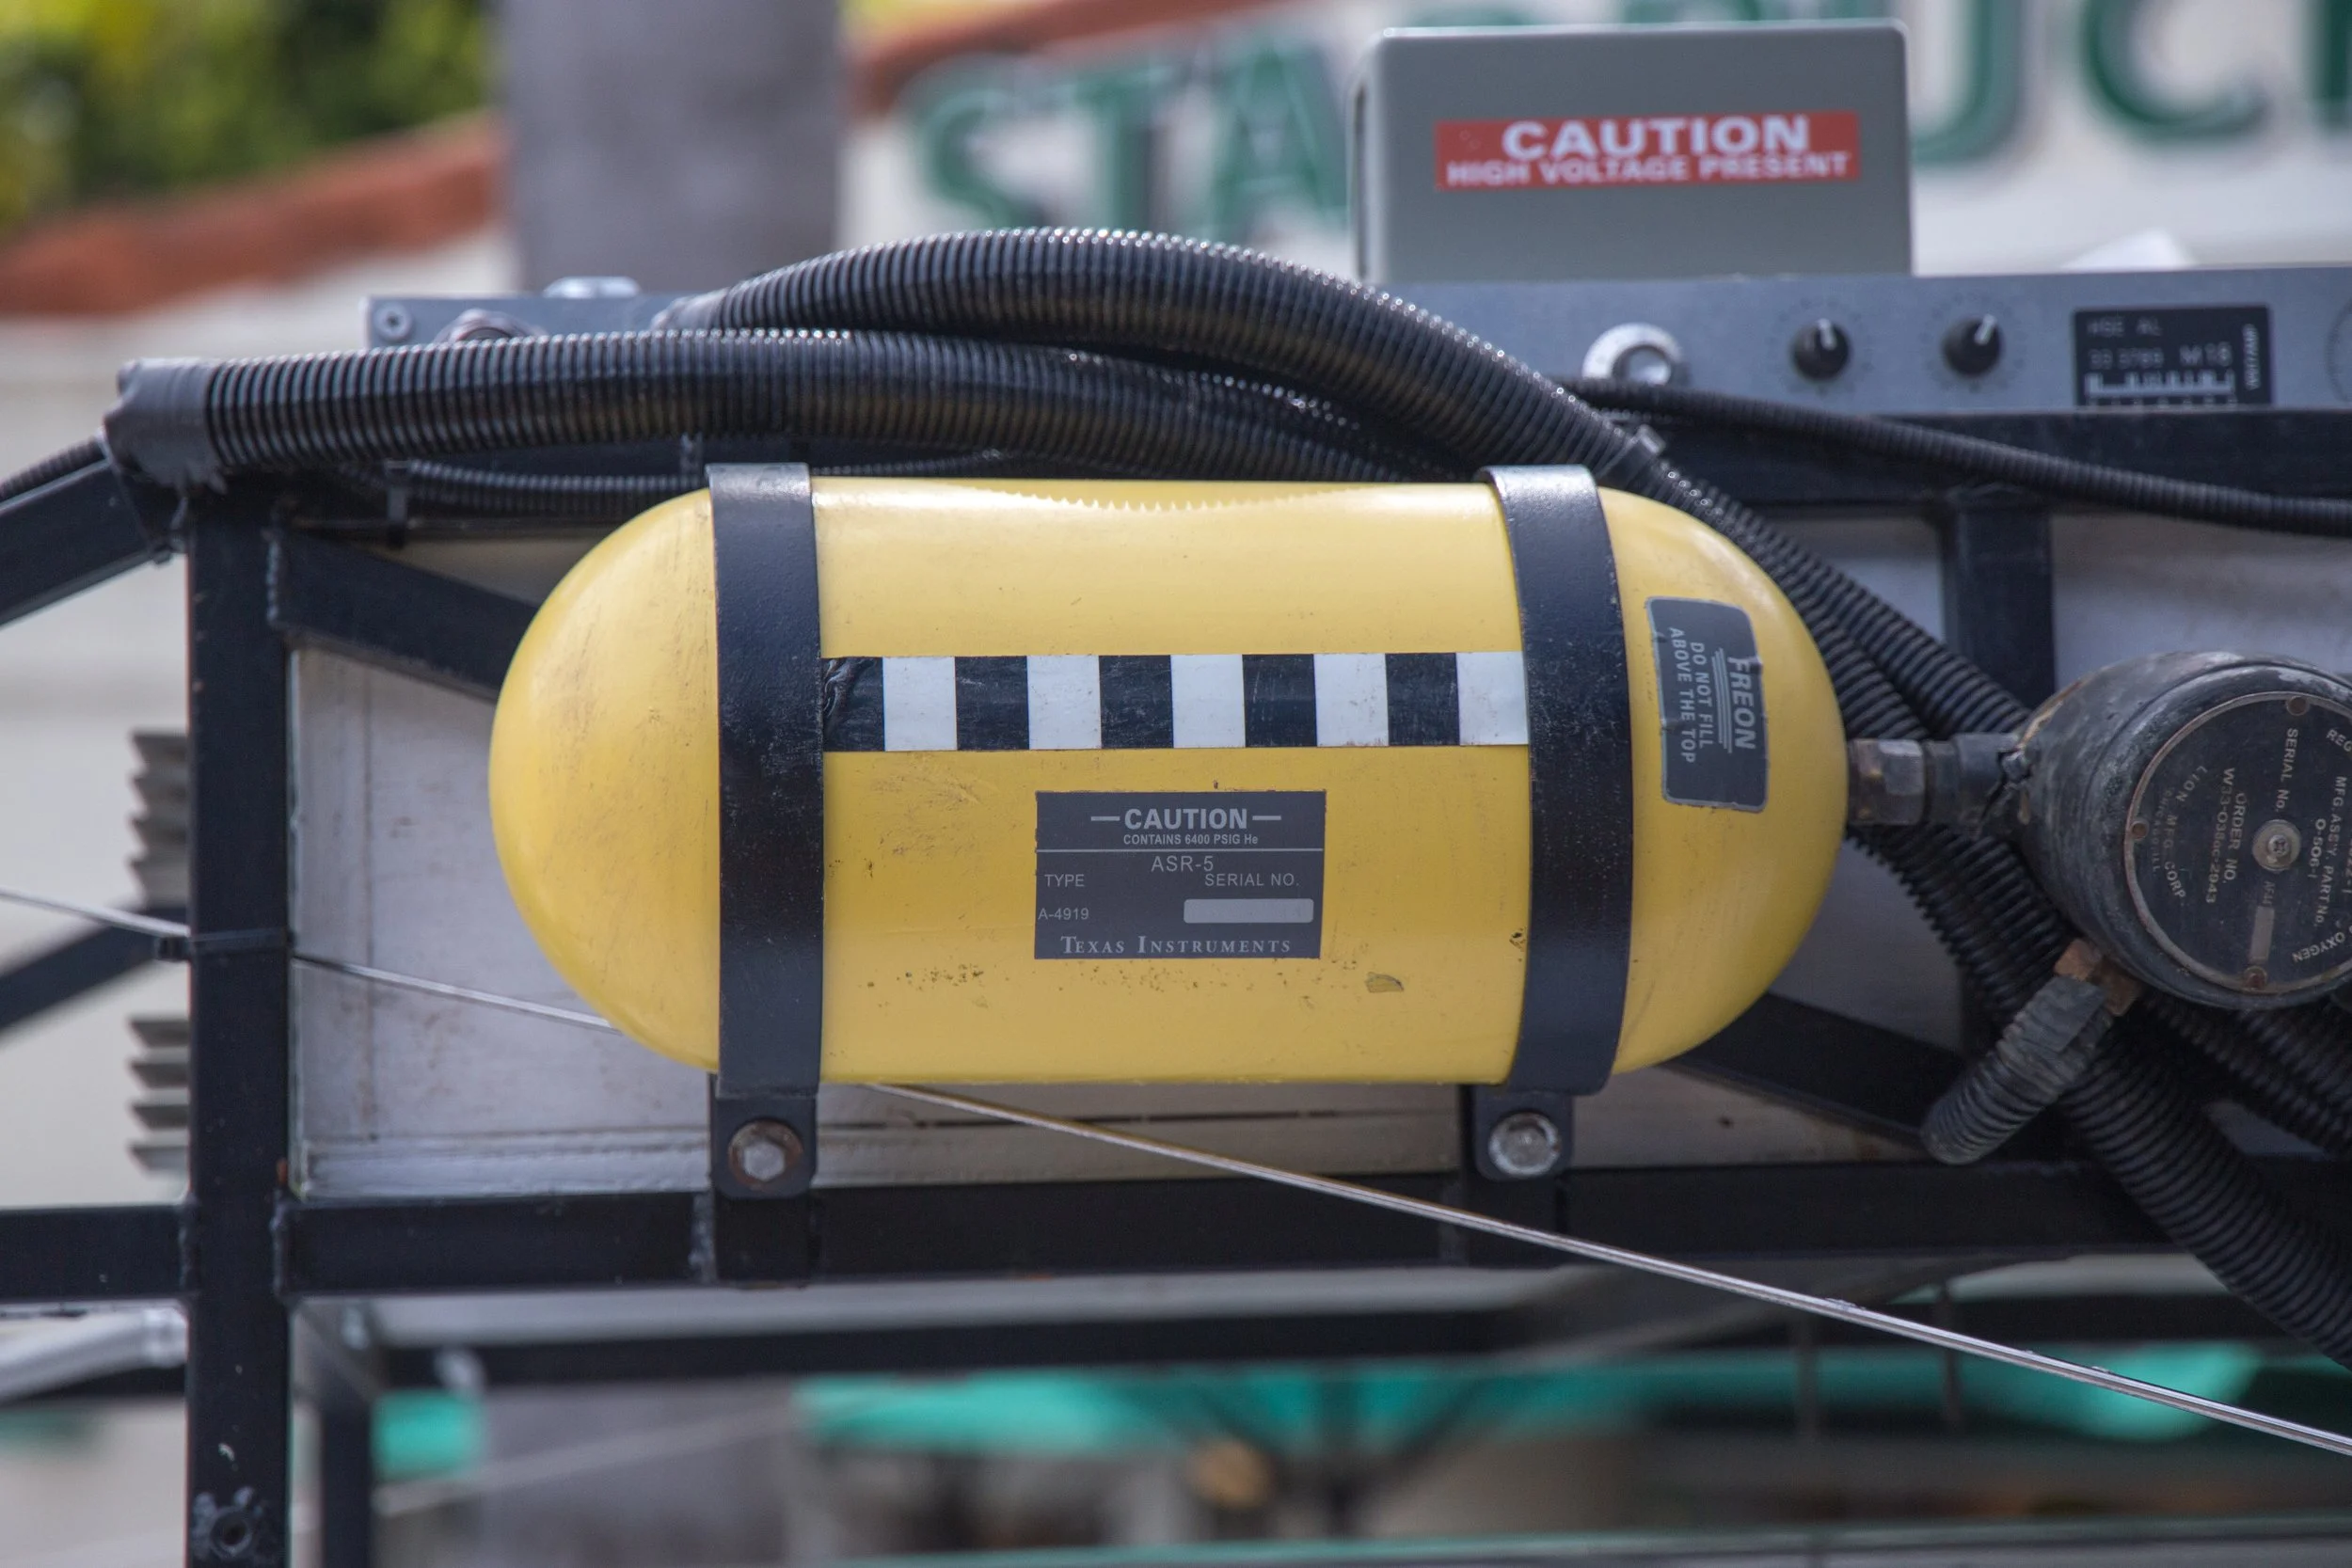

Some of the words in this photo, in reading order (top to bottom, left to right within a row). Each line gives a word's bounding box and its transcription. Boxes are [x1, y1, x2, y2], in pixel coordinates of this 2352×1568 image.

[1502, 115, 1809, 161] CAUTION
[1446, 159, 1530, 186] HIGH
[1539, 156, 1688, 183] VOLTAGE
[1698, 151, 1850, 180] PRESENT
[1669, 626, 1692, 682] ABOVE
[1690, 641, 1707, 666] DO
[1678, 689, 1695, 721] THE
[1694, 672, 1711, 707] NOT
[1727, 657, 1756, 750] FREON
[1680, 728, 1696, 763] TOP
[1698, 713, 1714, 750] FILL
[2280, 728, 2299, 783] SERIAL
[2175, 765, 2208, 801] LION
[1124, 808, 1248, 830] CAUTION
[2229, 792, 2248, 850] ORDER
[1123, 833, 1182, 846] CONTAINS
[1184, 833, 1210, 845] 6400
[1214, 833, 1240, 845] PSIG
[1244, 833, 1259, 845] He
[1044, 874, 1085, 887] TYPE
[1204, 872, 1264, 887] SERIAL
[1271, 872, 1300, 887] NO.
[1151, 855, 1215, 873] ASR-5
[2222, 858, 2238, 883] NO.
[2317, 865, 2334, 903] PART
[1038, 908, 1089, 921] A-4919
[2292, 931, 2345, 963] OXYGEN
